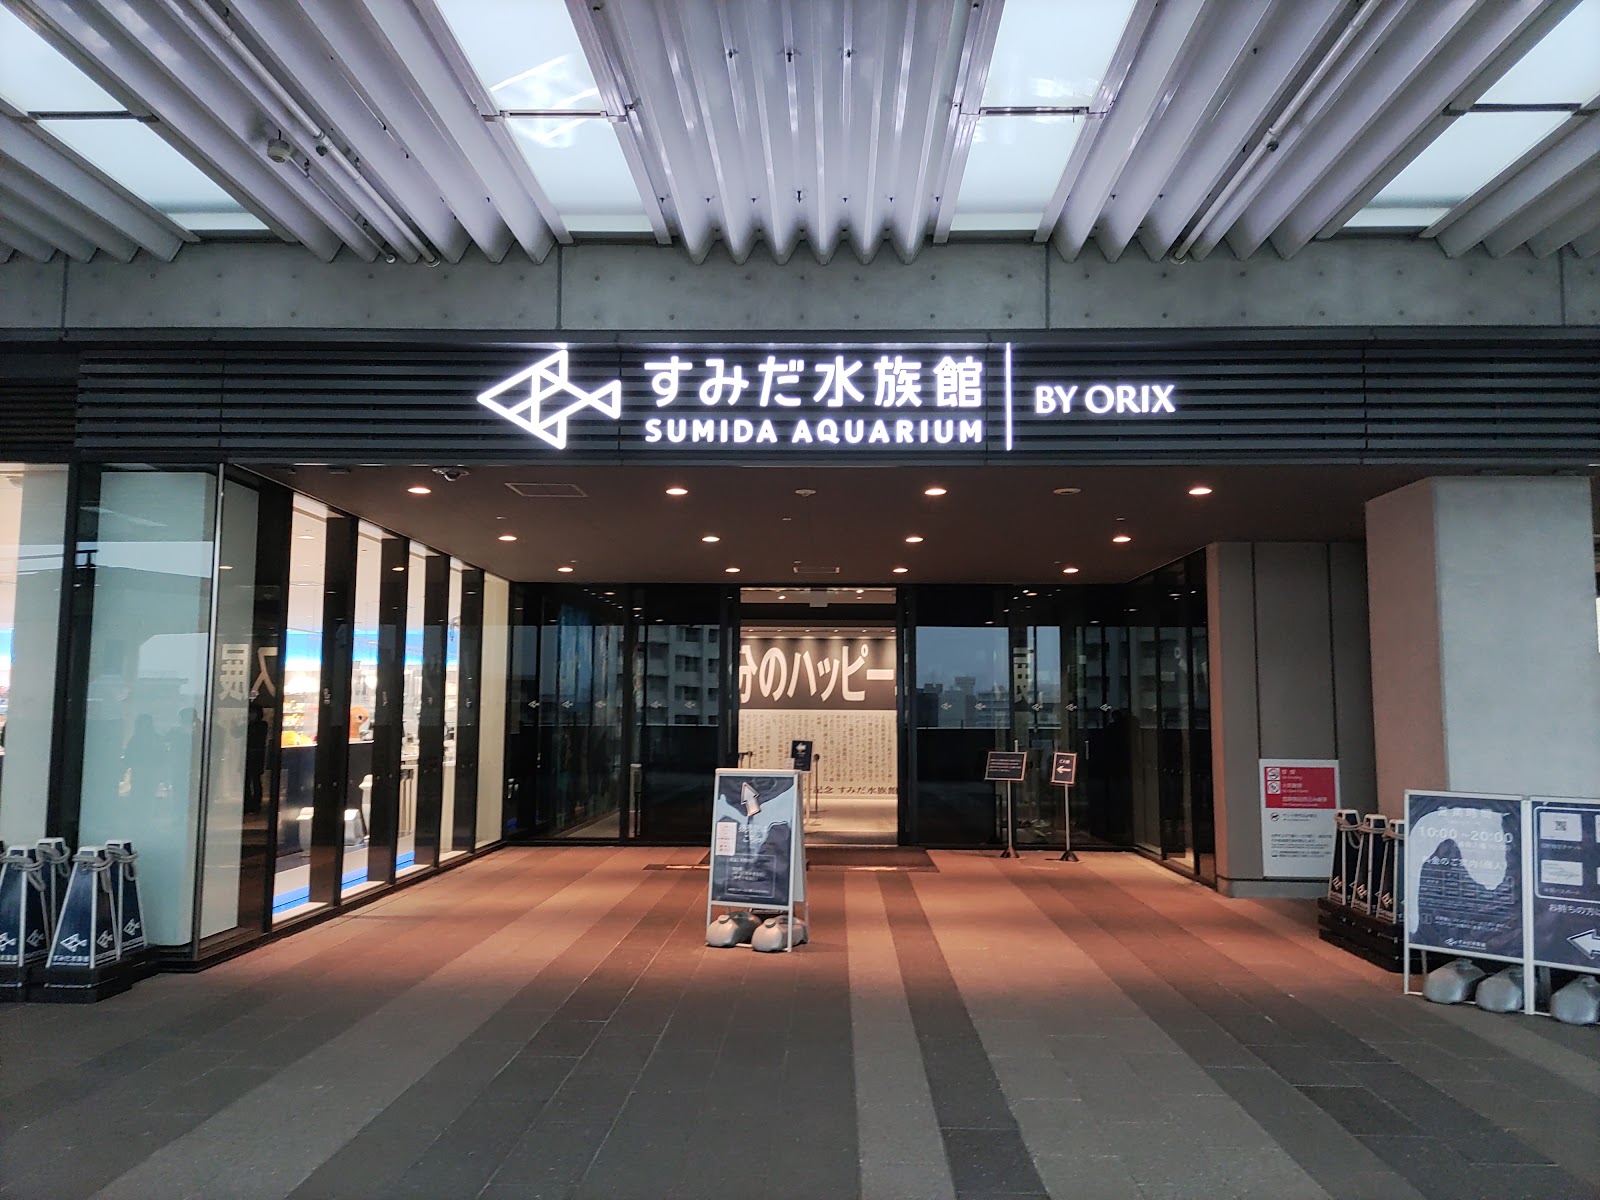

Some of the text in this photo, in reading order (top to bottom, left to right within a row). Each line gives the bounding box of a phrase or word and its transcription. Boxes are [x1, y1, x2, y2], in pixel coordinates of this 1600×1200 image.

[642, 355, 984, 409] すみだ水族館
[1035, 382, 1177, 415] BY ORIX
[643, 418, 984, 446] SUMIDA AQUARIUM
